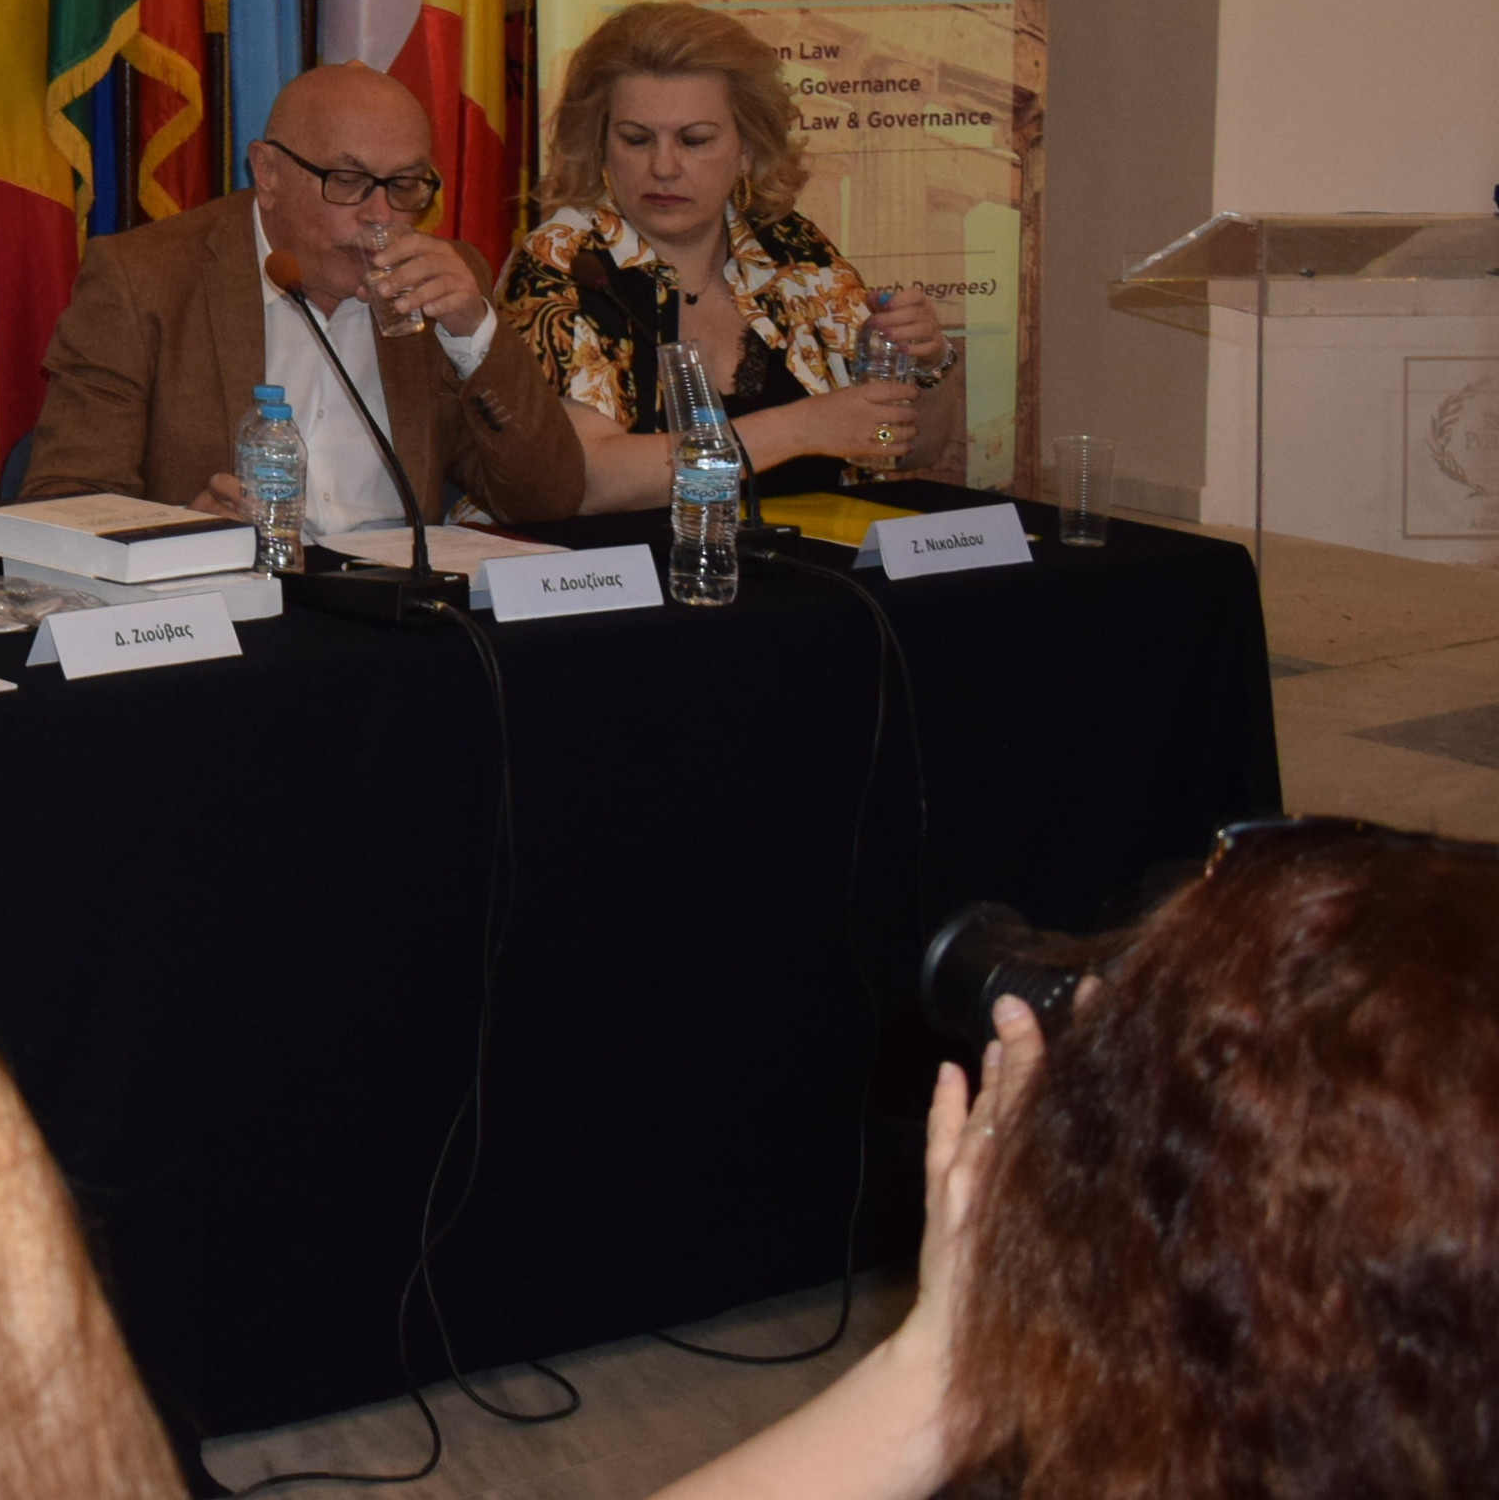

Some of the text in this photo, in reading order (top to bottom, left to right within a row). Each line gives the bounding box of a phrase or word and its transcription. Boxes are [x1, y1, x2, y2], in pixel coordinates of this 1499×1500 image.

[799, 43, 840, 60] Law
[800, 77, 921, 96] Governance
[800, 111, 992, 131] Law & Governance
[925, 532, 984, 551] Νικολάου
[541, 572, 622, 593] Κ. Δουζίνας
[115, 623, 194, 646] Δ. Ζιούβας
